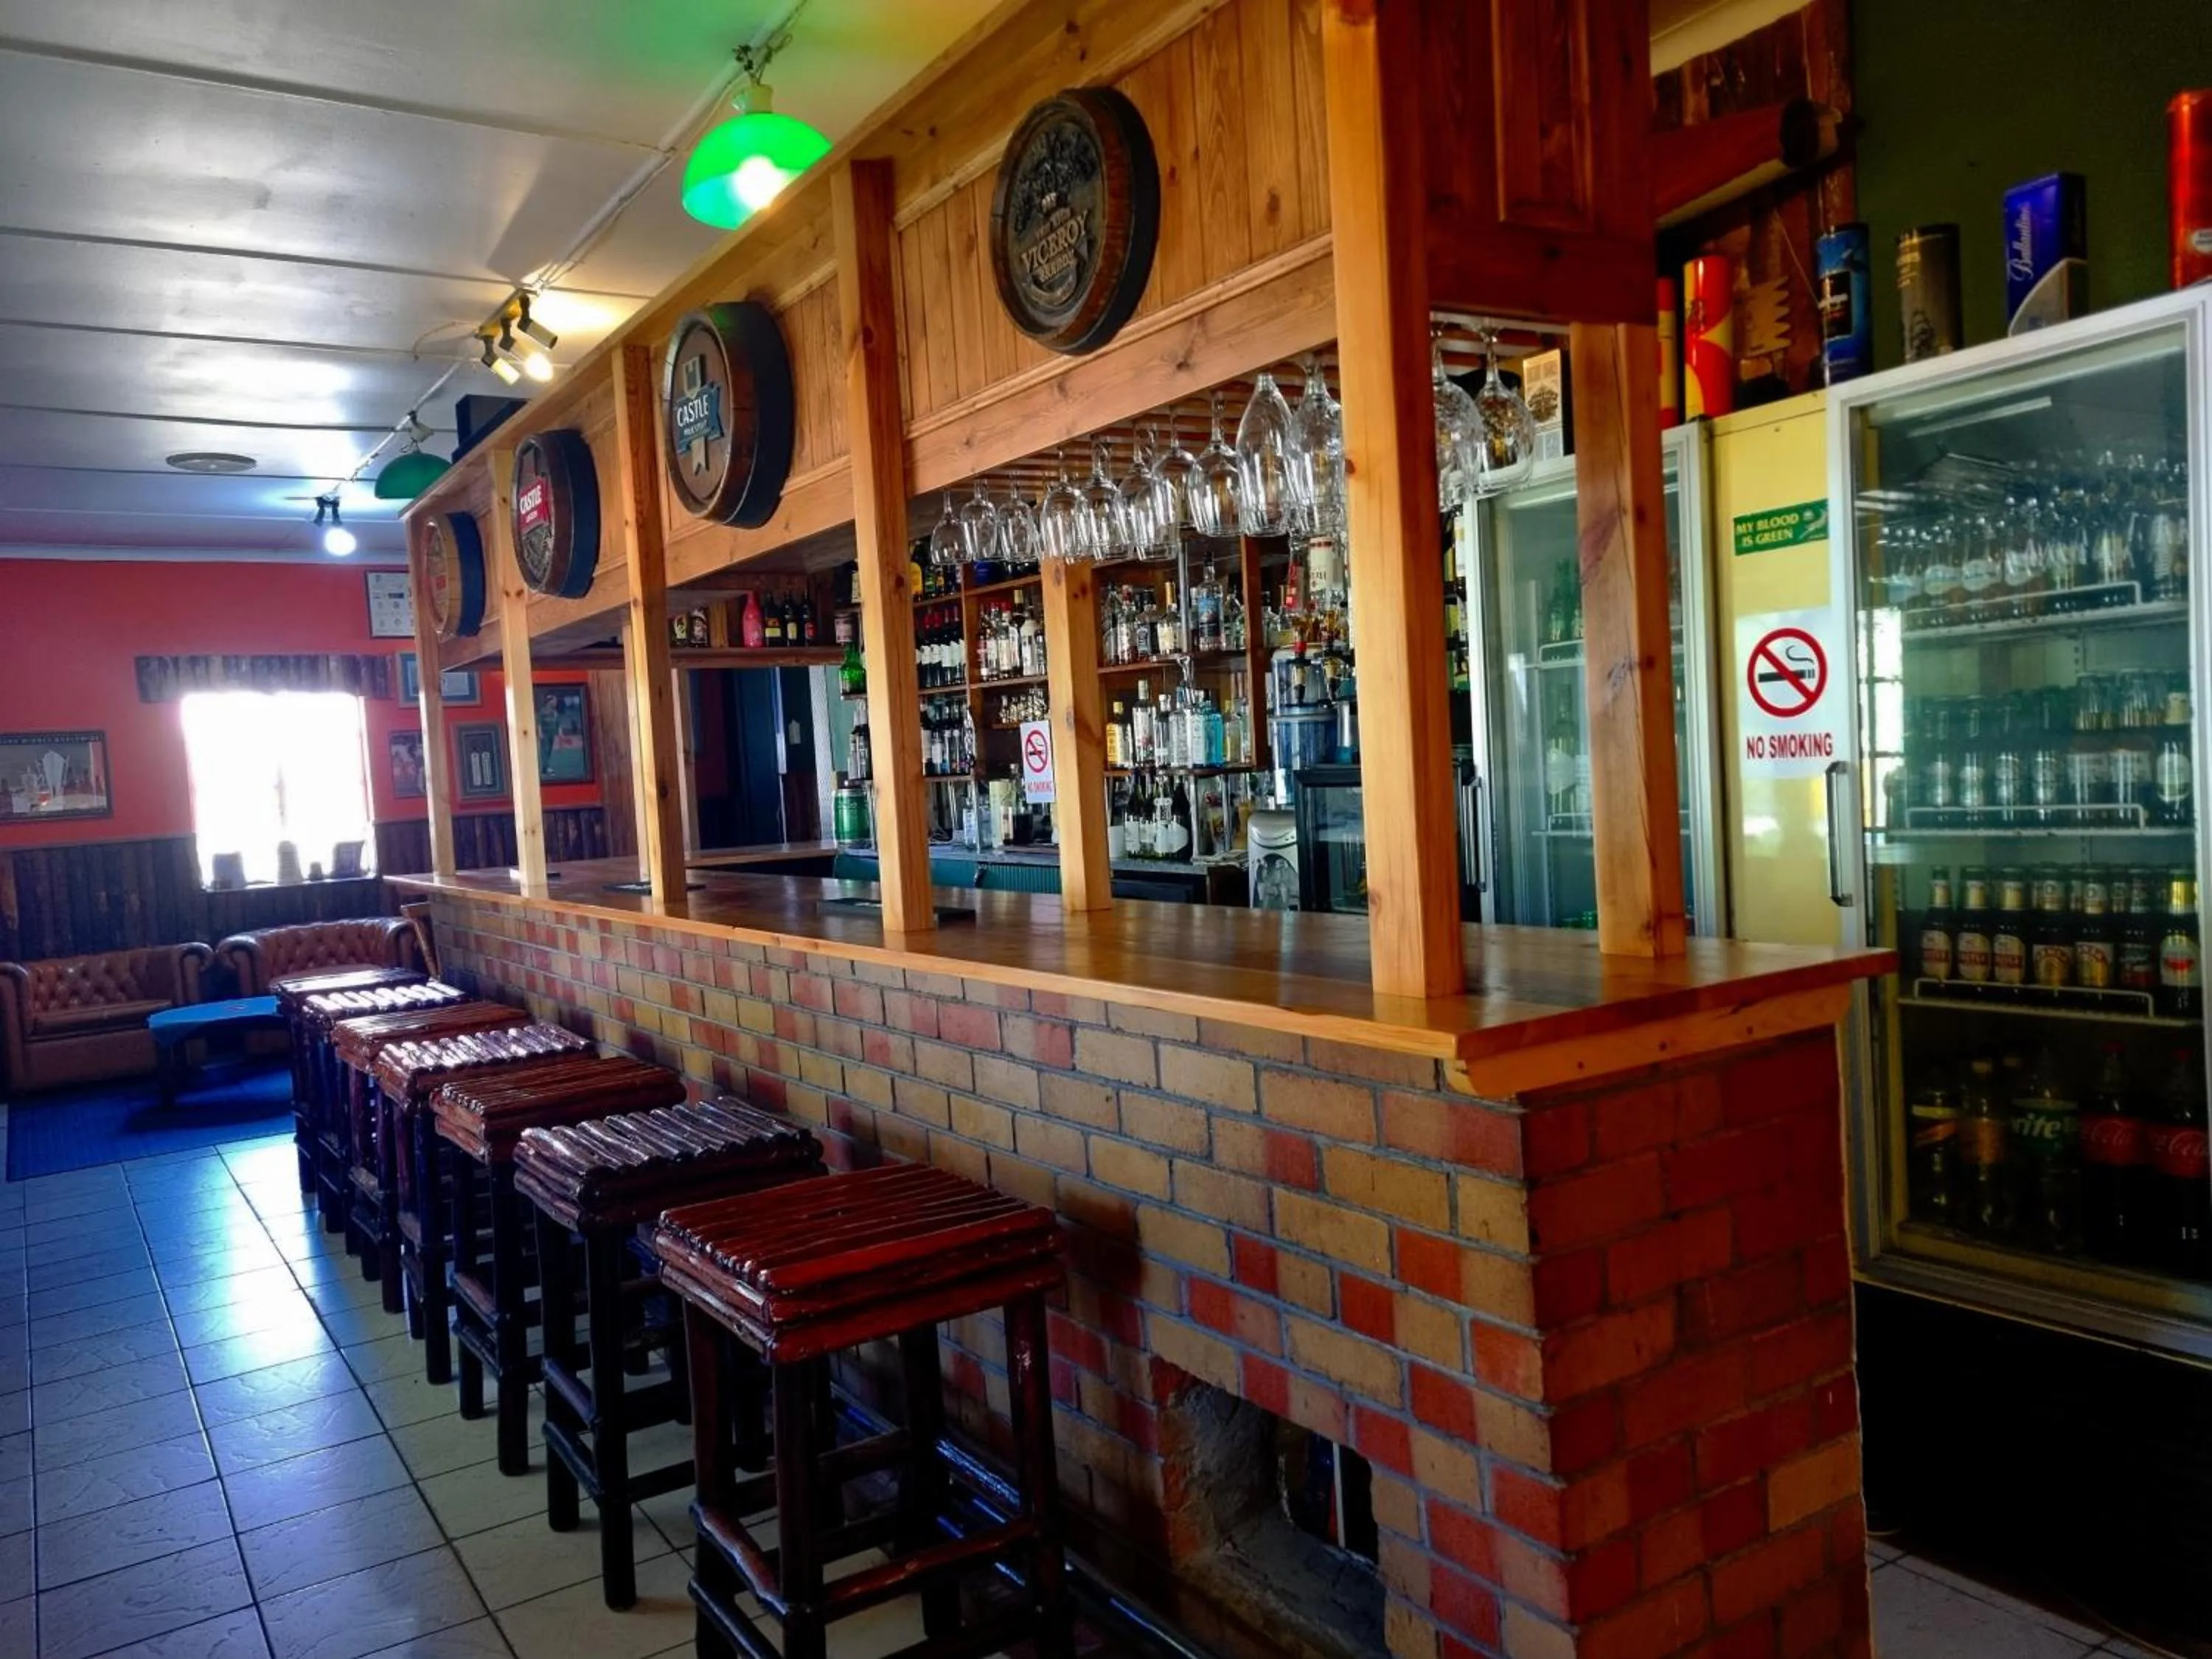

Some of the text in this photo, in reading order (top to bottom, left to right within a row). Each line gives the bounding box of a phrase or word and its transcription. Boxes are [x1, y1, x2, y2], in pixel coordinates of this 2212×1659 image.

[1020, 210, 1088, 274] VICEROY
[677, 394, 709, 427] CASTLE
[520, 484, 543, 515] CASTLE
[1736, 512, 1799, 535] MY BLOOD
[1742, 527, 1794, 546] IS GREEN
[1747, 732, 1834, 759] NO SMOKING
